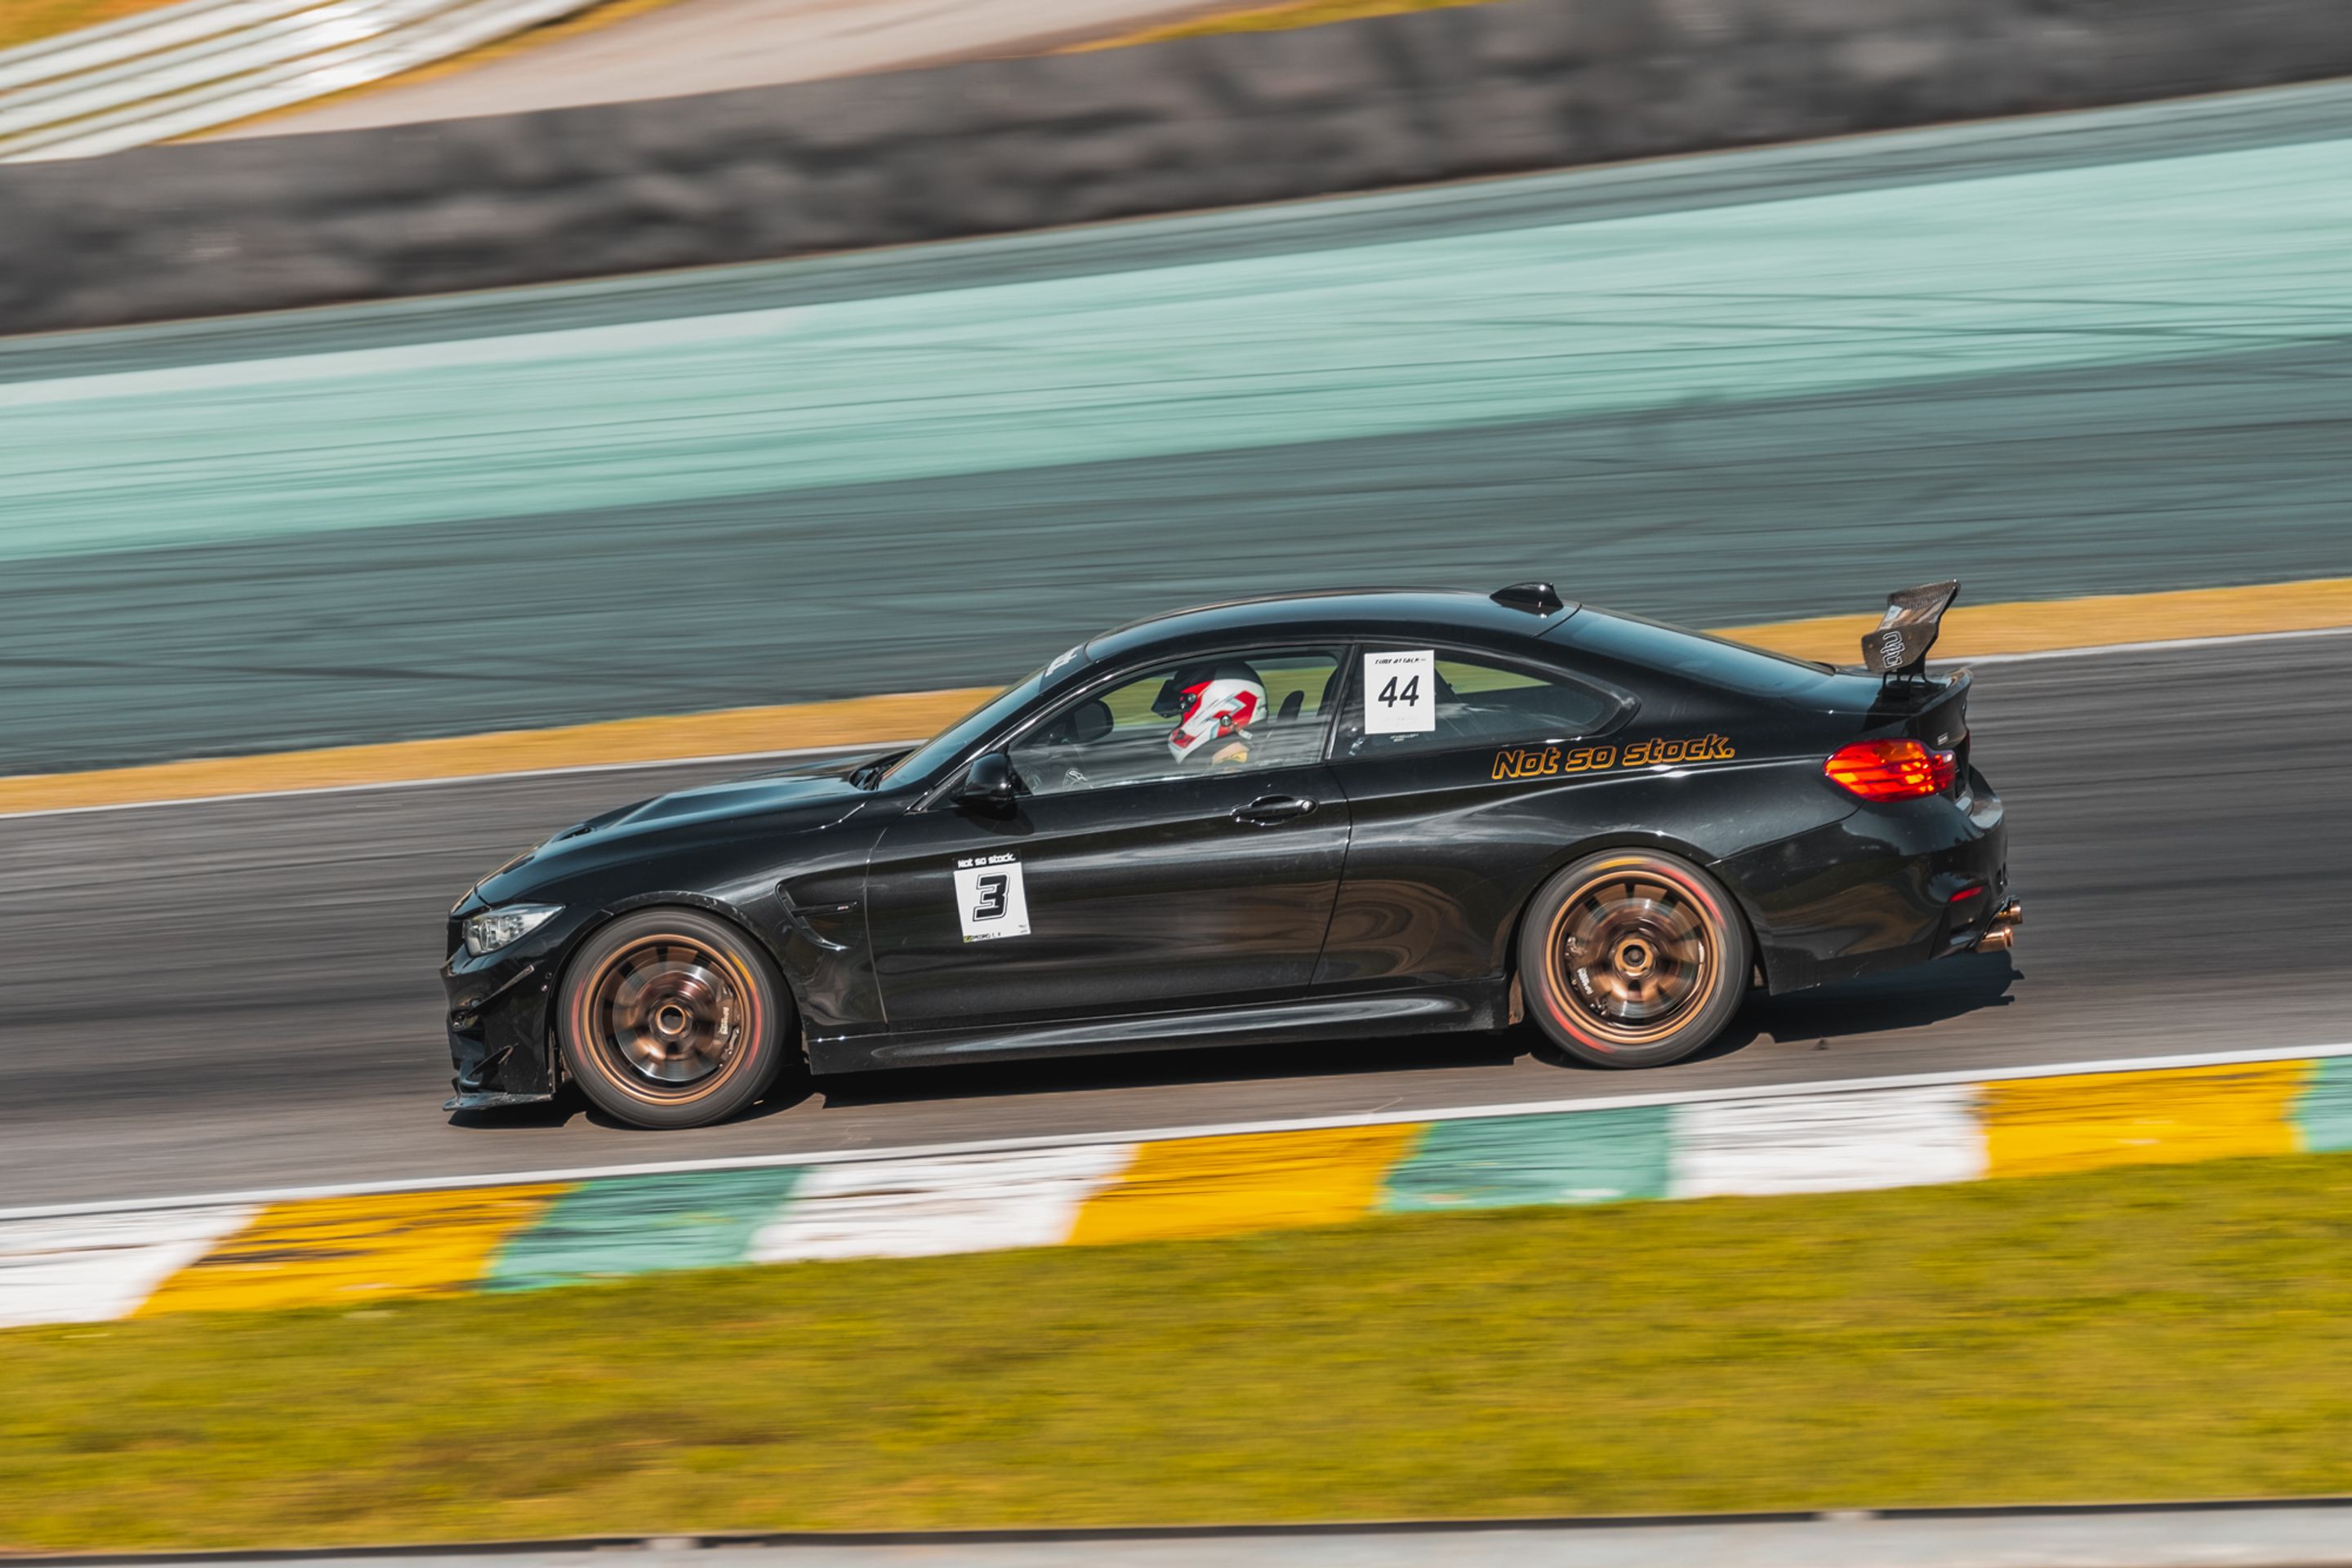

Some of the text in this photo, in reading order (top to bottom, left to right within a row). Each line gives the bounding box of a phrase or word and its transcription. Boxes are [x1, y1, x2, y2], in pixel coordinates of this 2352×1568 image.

[1378, 675, 1419, 708] 44
[1491, 733, 1735, 780] Not so stock.
[973, 871, 1011, 922] 3
